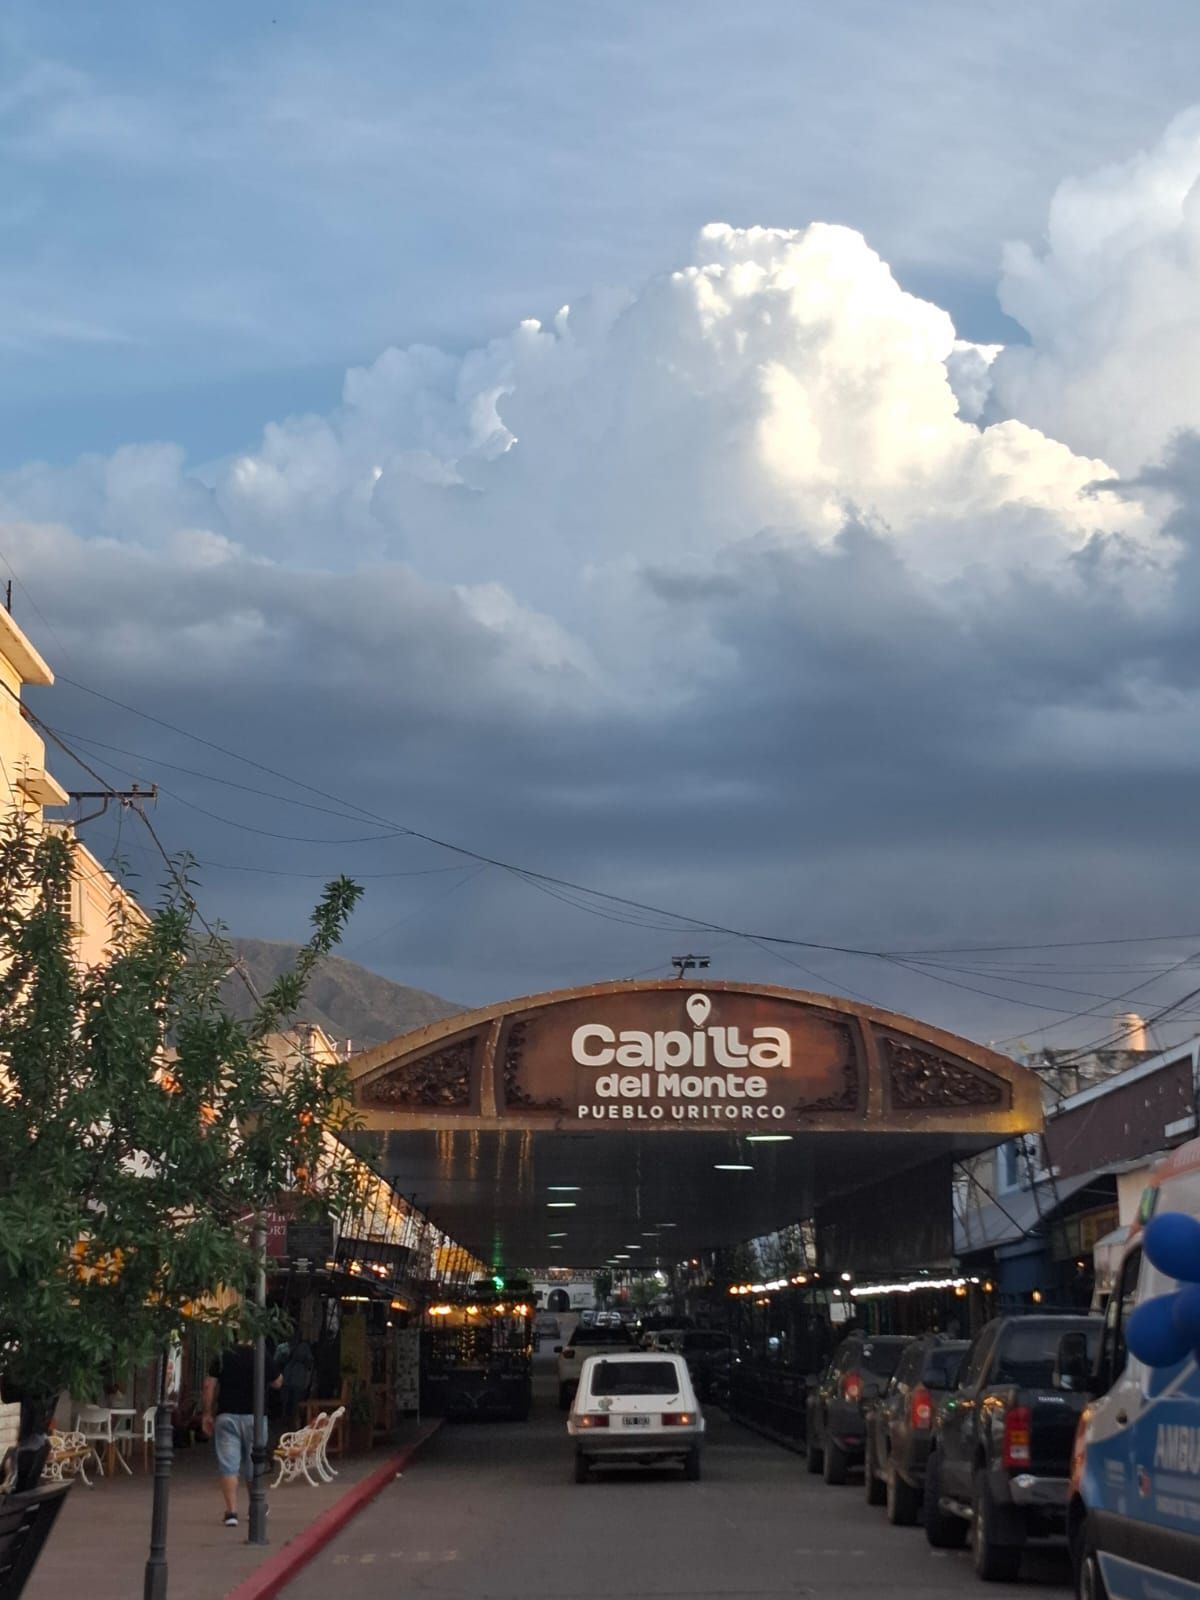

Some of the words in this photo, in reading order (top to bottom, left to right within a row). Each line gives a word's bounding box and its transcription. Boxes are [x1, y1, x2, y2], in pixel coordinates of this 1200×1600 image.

[571, 1022, 792, 1071] Capilla
[595, 1073, 650, 1098] del
[657, 1073, 768, 1098] Monte
[577, 1105, 664, 1119] PUEBLO
[671, 1105, 786, 1119] URITORCO
